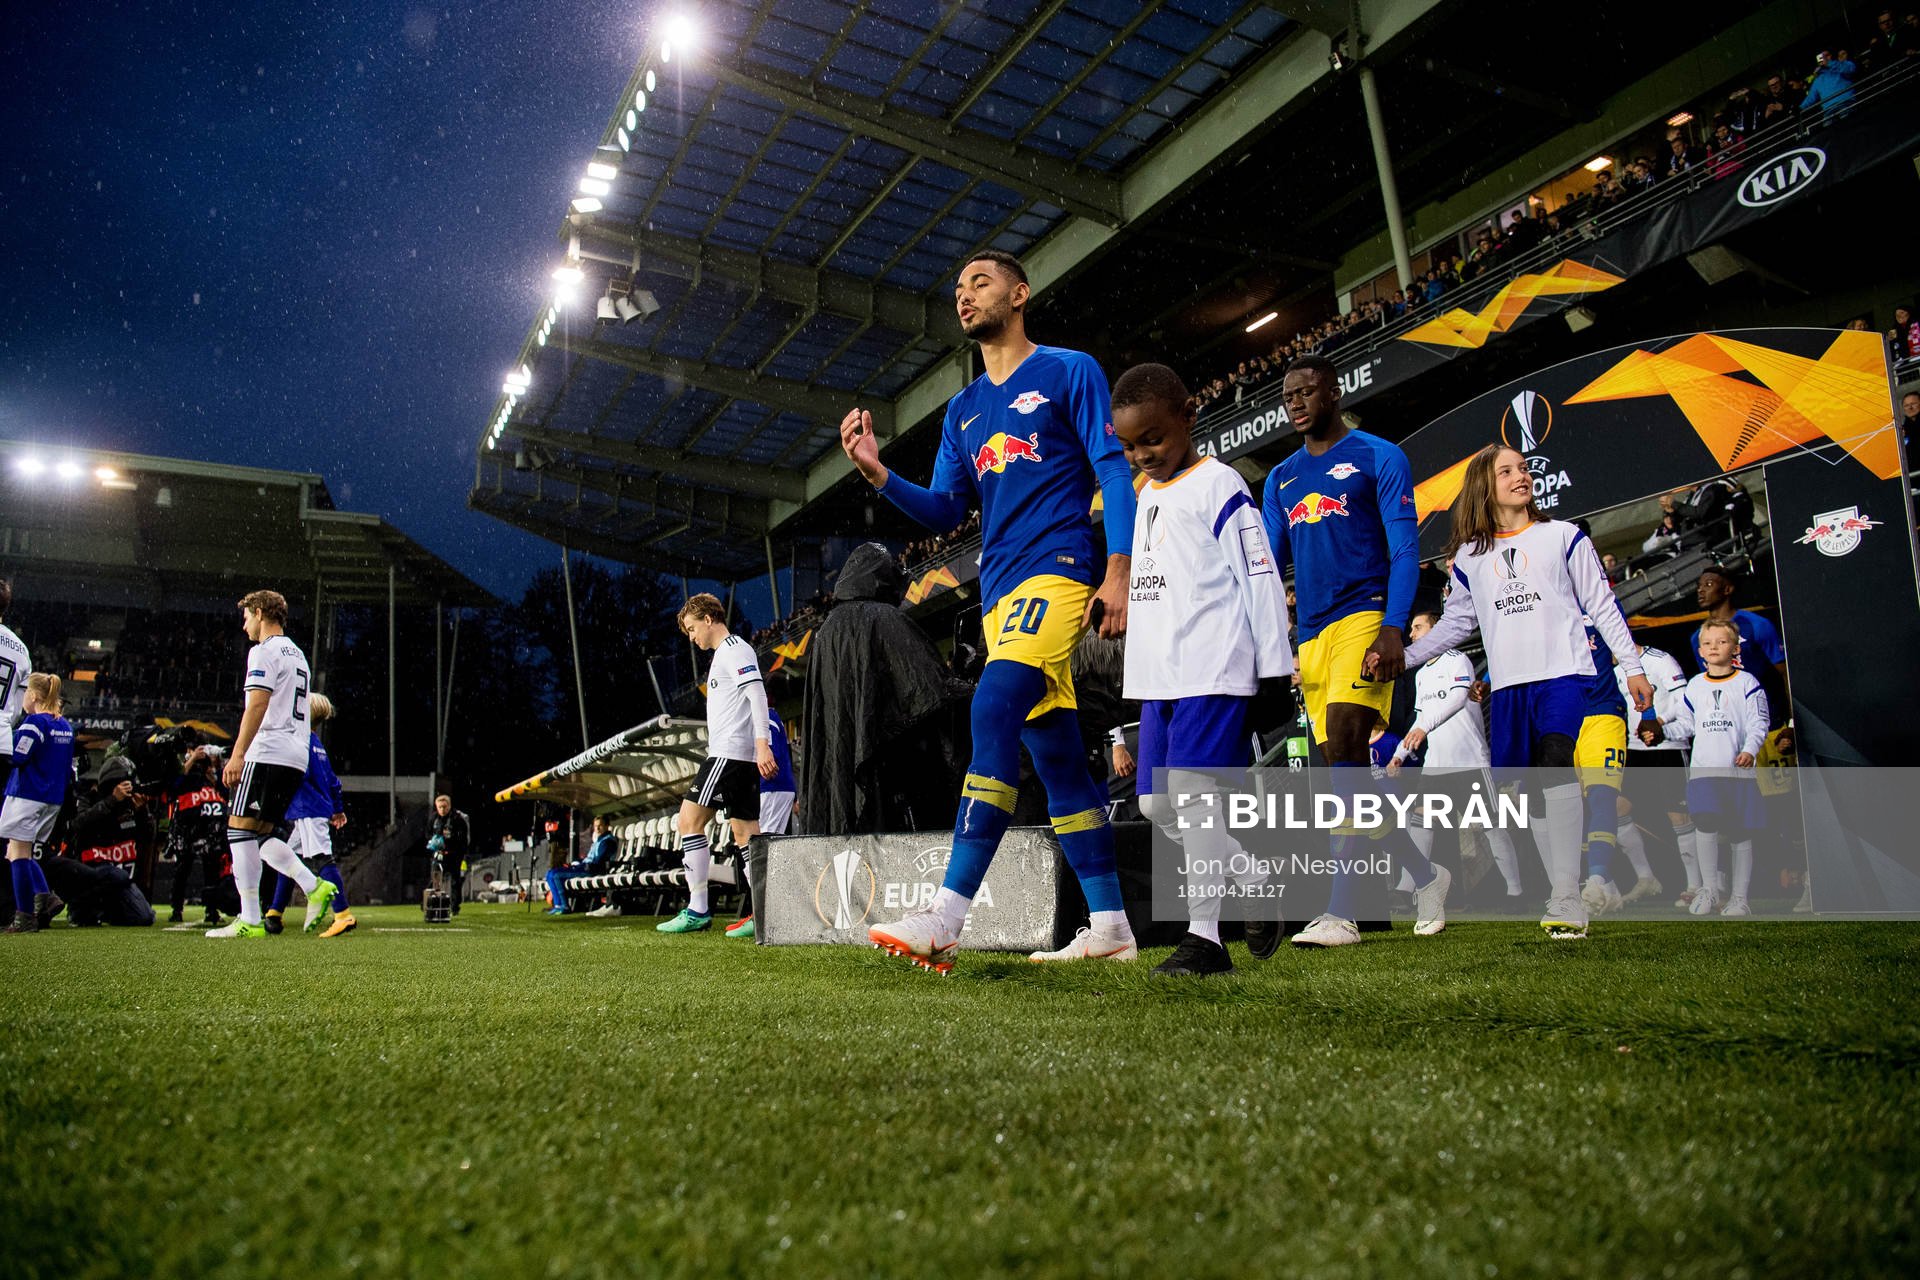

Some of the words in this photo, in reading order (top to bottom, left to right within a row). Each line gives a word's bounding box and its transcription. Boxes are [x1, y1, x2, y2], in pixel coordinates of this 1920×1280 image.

[1750, 156, 1812, 201] KIA
[1220, 405, 1290, 454] EUROPA
[1337, 362, 1373, 400] GUE
[1532, 470, 1572, 497] OPA
[1535, 493, 1559, 511] GUE
[1130, 575, 1167, 590] UROPA
[1130, 591, 1160, 602] LEAGUE
[1494, 591, 1542, 611] EUROPA
[1002, 597, 1050, 635] 20
[1503, 603, 1534, 616] LEAGUE
[292, 667, 308, 722] 2
[1702, 720, 1733, 729] EUROPA
[915, 850, 952, 873] UEF
[884, 881, 995, 908] EURA
